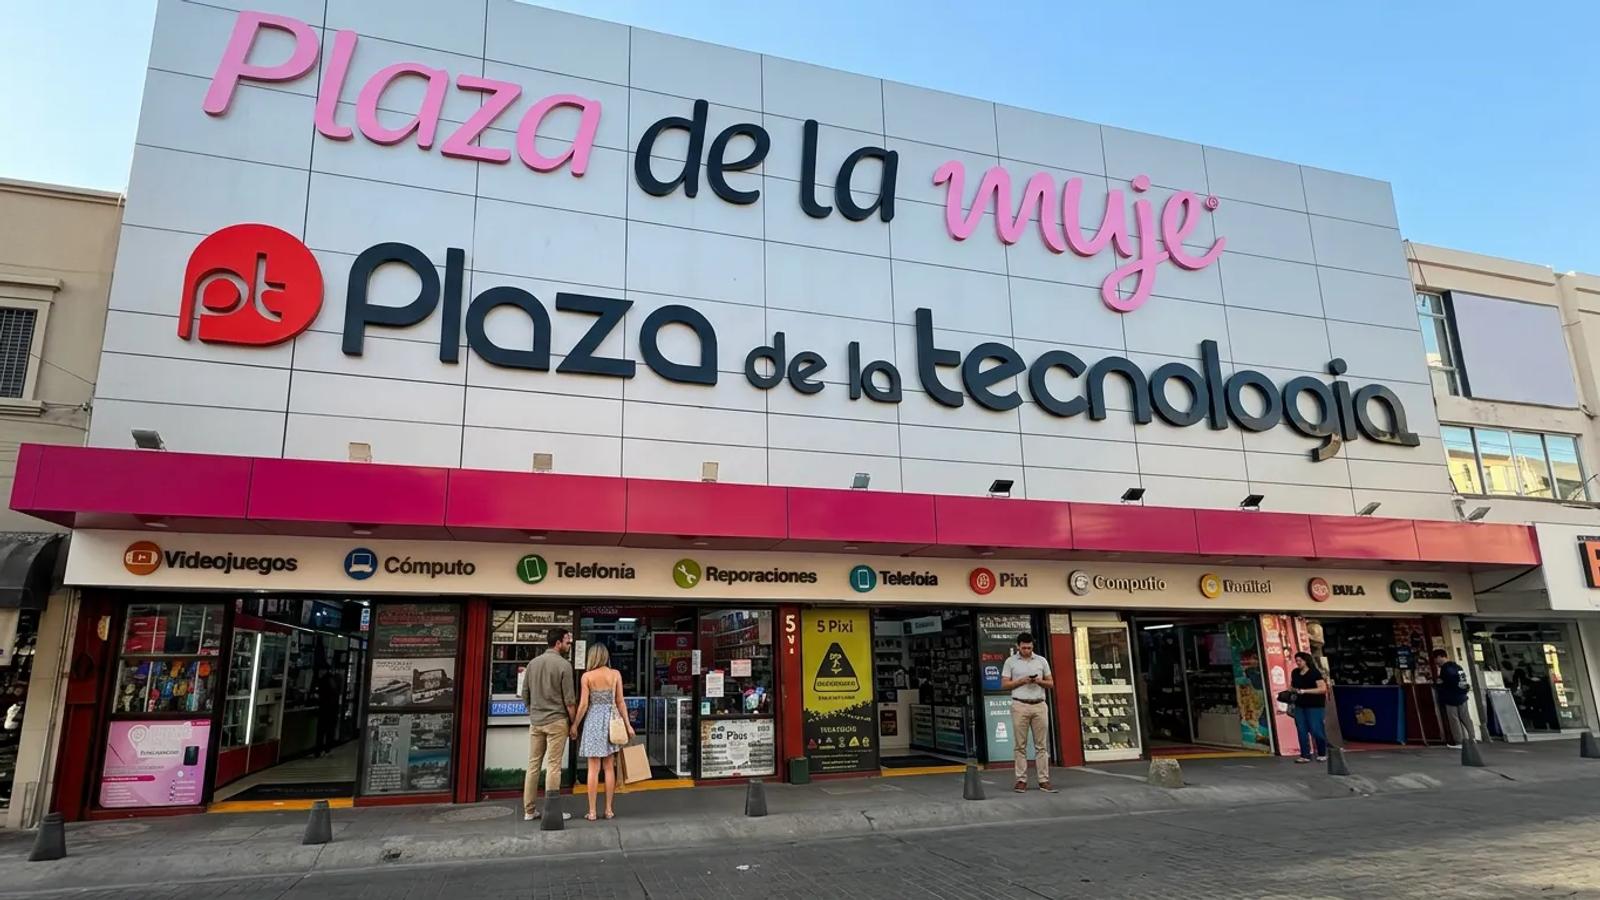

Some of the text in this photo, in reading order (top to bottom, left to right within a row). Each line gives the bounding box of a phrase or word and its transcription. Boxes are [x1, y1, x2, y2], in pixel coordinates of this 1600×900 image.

[202, 10, 1226, 313] Plaza de la muje
[342, 241, 1420, 462] Plaza de la tecnologia
[164, 550, 298, 576] Videojuegos
[384, 556, 476, 579] Cómputo
[706, 566, 818, 585] Reporaciones
[1000, 572, 1028, 588] Pixi
[817, 620, 853, 633] 5 Pixi
